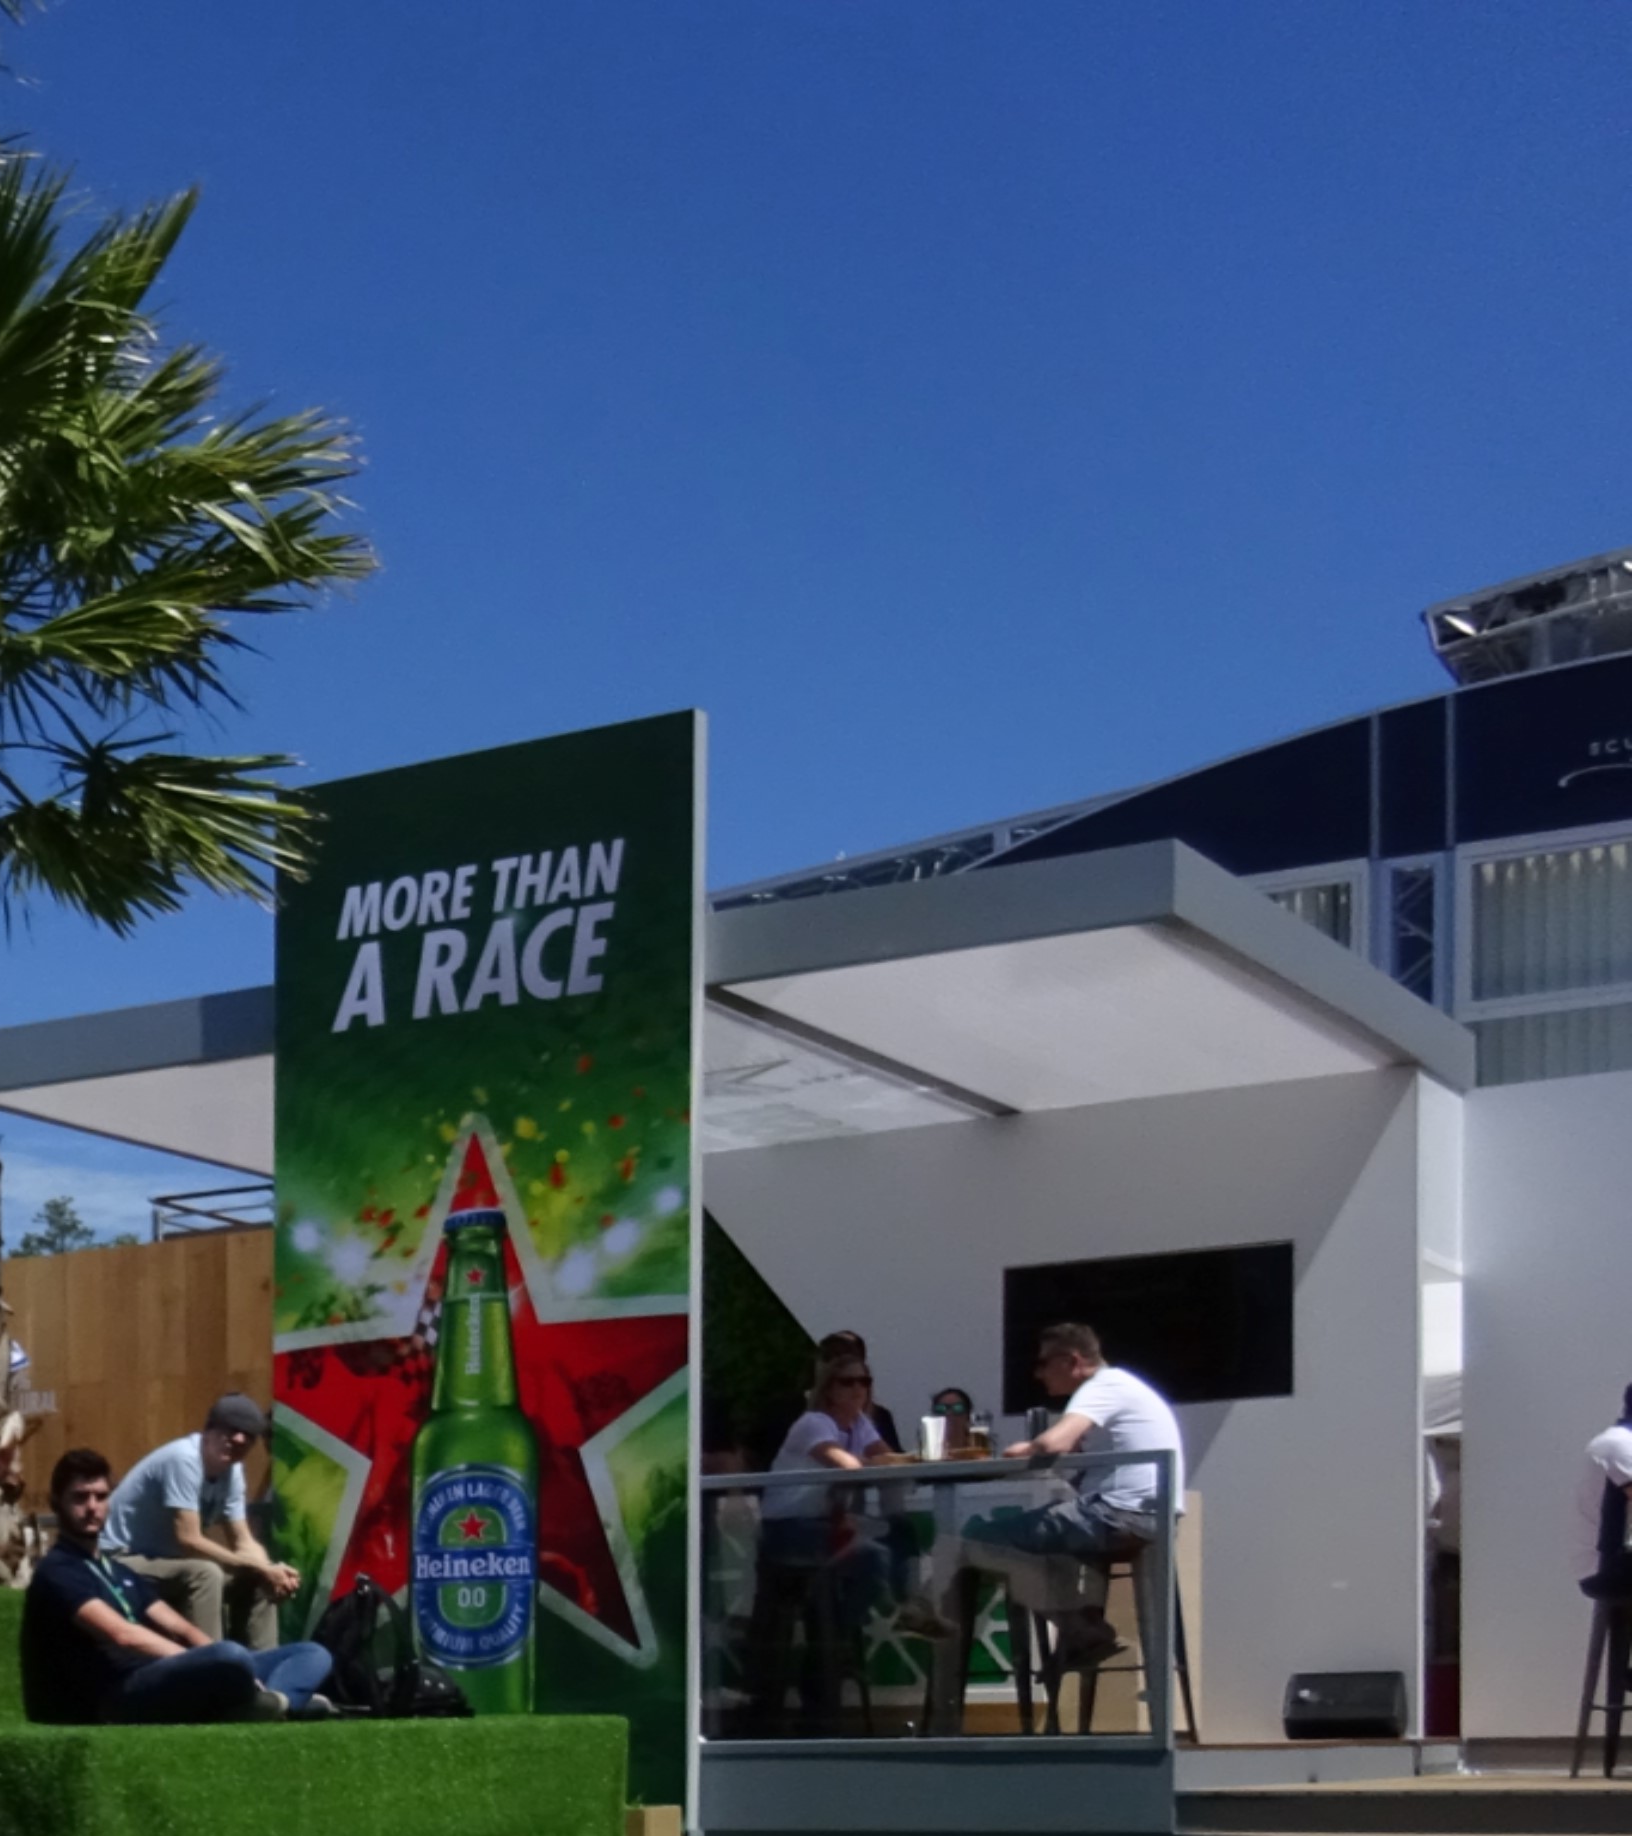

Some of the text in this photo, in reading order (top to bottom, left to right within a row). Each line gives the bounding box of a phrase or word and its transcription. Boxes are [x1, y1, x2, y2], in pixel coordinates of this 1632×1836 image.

[336, 838, 626, 940] MORE THAN
[331, 901, 616, 1034] A RACE
[416, 1552, 531, 1579] Heineken
